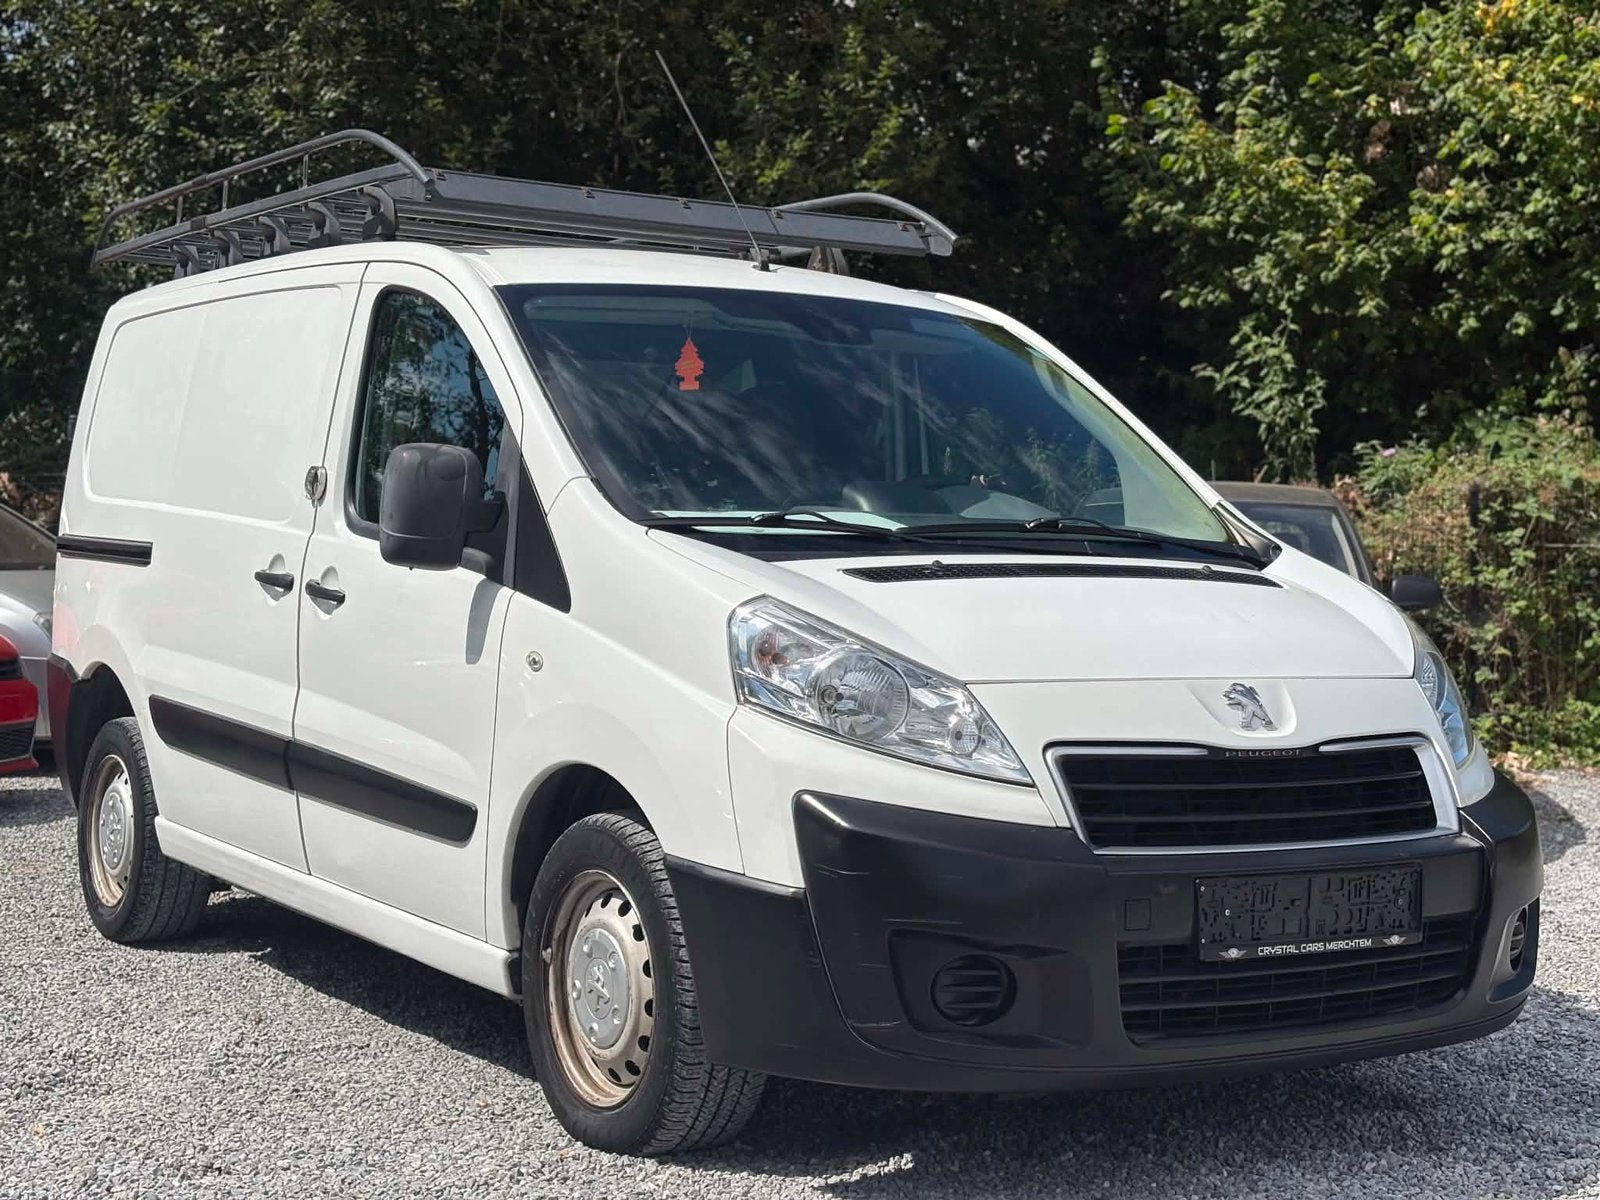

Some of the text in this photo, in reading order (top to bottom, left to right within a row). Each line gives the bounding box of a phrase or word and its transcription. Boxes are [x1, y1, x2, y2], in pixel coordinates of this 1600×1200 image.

[1225, 749, 1301, 757] PEUGEOT
[1257, 938, 1372, 955] CRYSTAL CARS MERCHTEM
